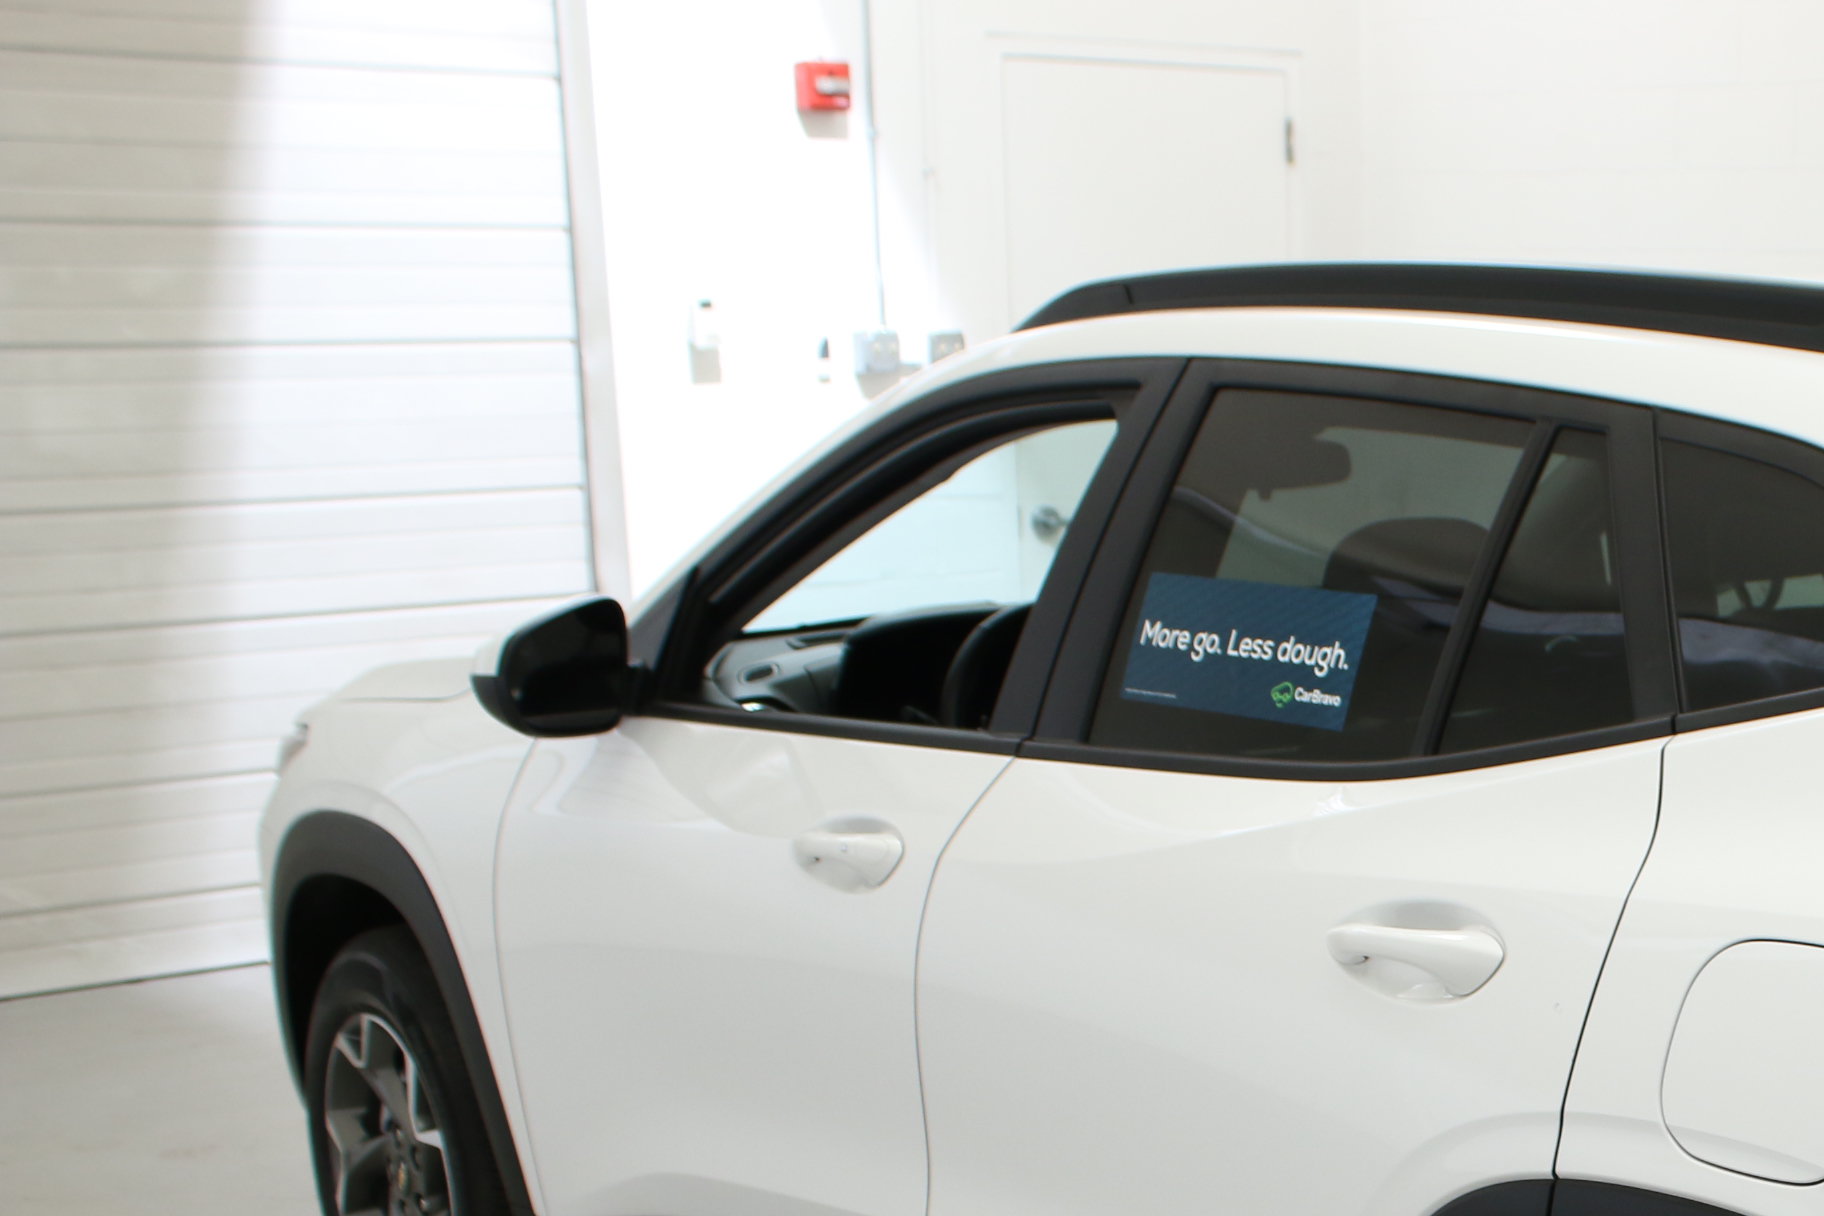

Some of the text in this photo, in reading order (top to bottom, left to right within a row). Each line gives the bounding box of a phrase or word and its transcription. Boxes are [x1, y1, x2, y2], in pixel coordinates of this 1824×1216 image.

[1139, 619, 1350, 678] More go. Less dough.
[1293, 686, 1343, 708] CarBravo
